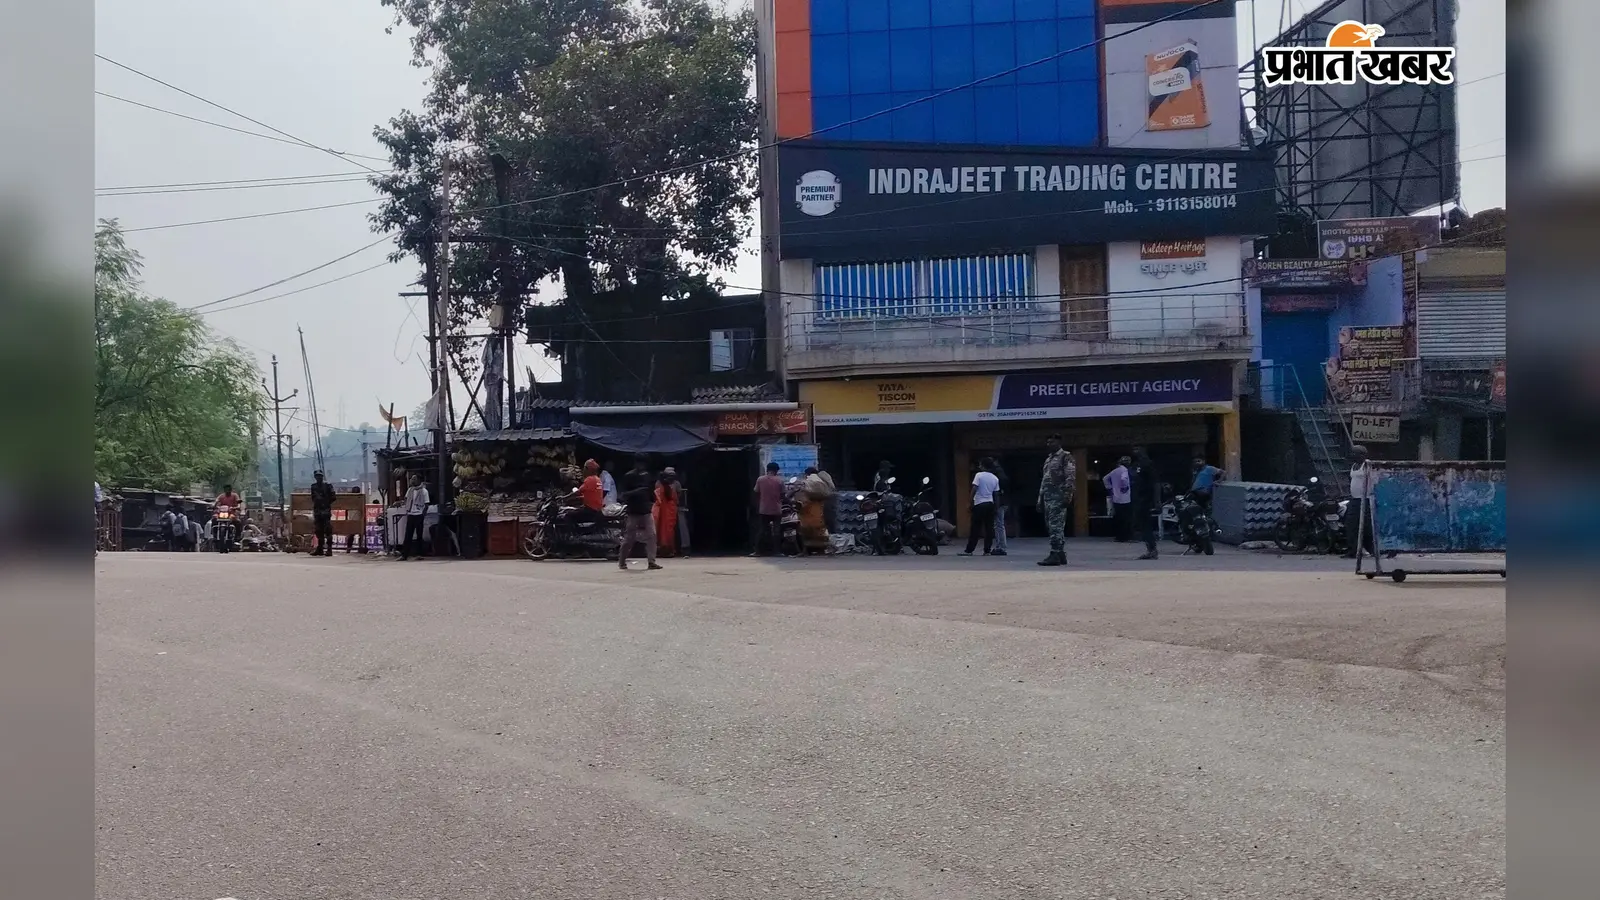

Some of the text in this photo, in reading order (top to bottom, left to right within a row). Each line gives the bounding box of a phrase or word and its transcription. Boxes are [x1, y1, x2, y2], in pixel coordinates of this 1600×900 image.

[868, 162, 1237, 194] INDRAJEET TRADING CENTRE
[800, 185, 836, 193] PREMIUM
[1104, 200, 1139, 214] Mob.
[1141, 263, 1177, 273] SINCE
[1284, 261, 1313, 270] BEAUTY
[878, 383, 905, 391] TATA
[1029, 379, 1200, 397] PREETI CEMENT AGENCY
[878, 392, 915, 401] TISCON
[718, 422, 755, 430] SNACKS
[1354, 416, 1394, 428] TO-LET
